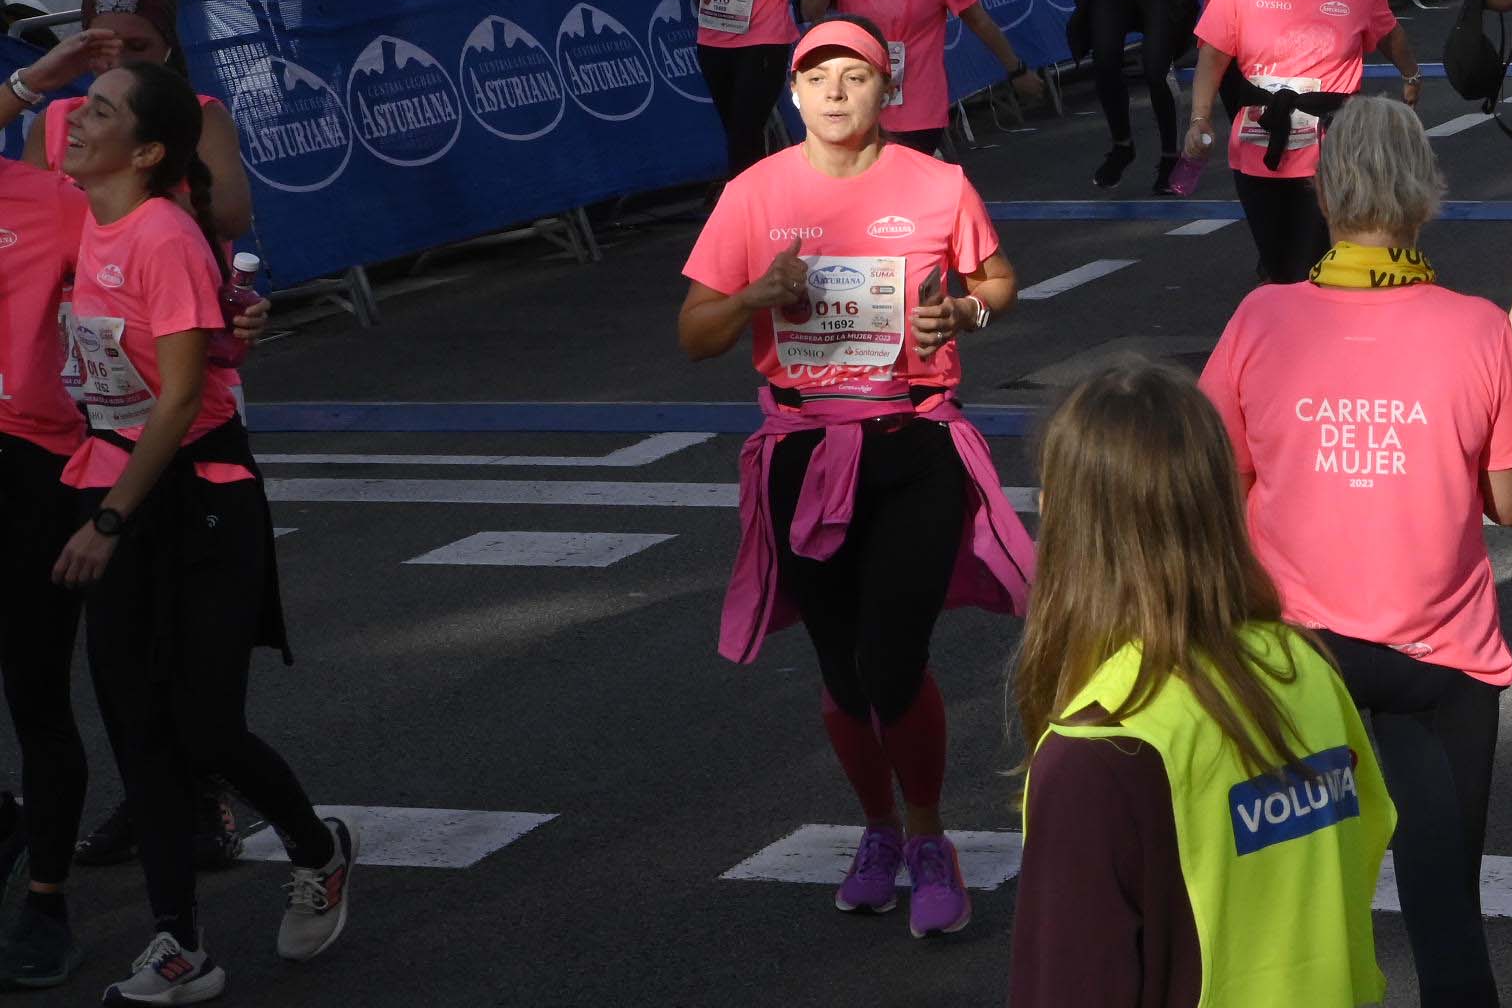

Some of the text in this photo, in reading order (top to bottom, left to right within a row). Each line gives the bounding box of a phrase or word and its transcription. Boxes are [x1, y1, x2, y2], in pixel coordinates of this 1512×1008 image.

[1256, 0, 1292, 10] OYSHO
[562, 49, 650, 97] ASTURIANA
[469, 66, 562, 115] ASTURIANA
[358, 90, 458, 140] ASTURIANA
[245, 114, 348, 165] ASTURIANA
[769, 226, 824, 241] OYSHO
[812, 276, 861, 285] ASTURIANA
[815, 300, 860, 316] 016
[820, 319, 855, 331] 11692
[790, 334, 824, 342] CARRERA
[825, 334, 835, 342] DE
[847, 333, 873, 341] MUJER
[787, 348, 890, 358] OYSHO Santander
[87, 359, 108, 378] 016
[1294, 397, 1428, 425] CARRERA
[1320, 424, 1402, 449] DE LA
[1314, 451, 1407, 475] MUJER
[1349, 478, 1374, 488] 2023
